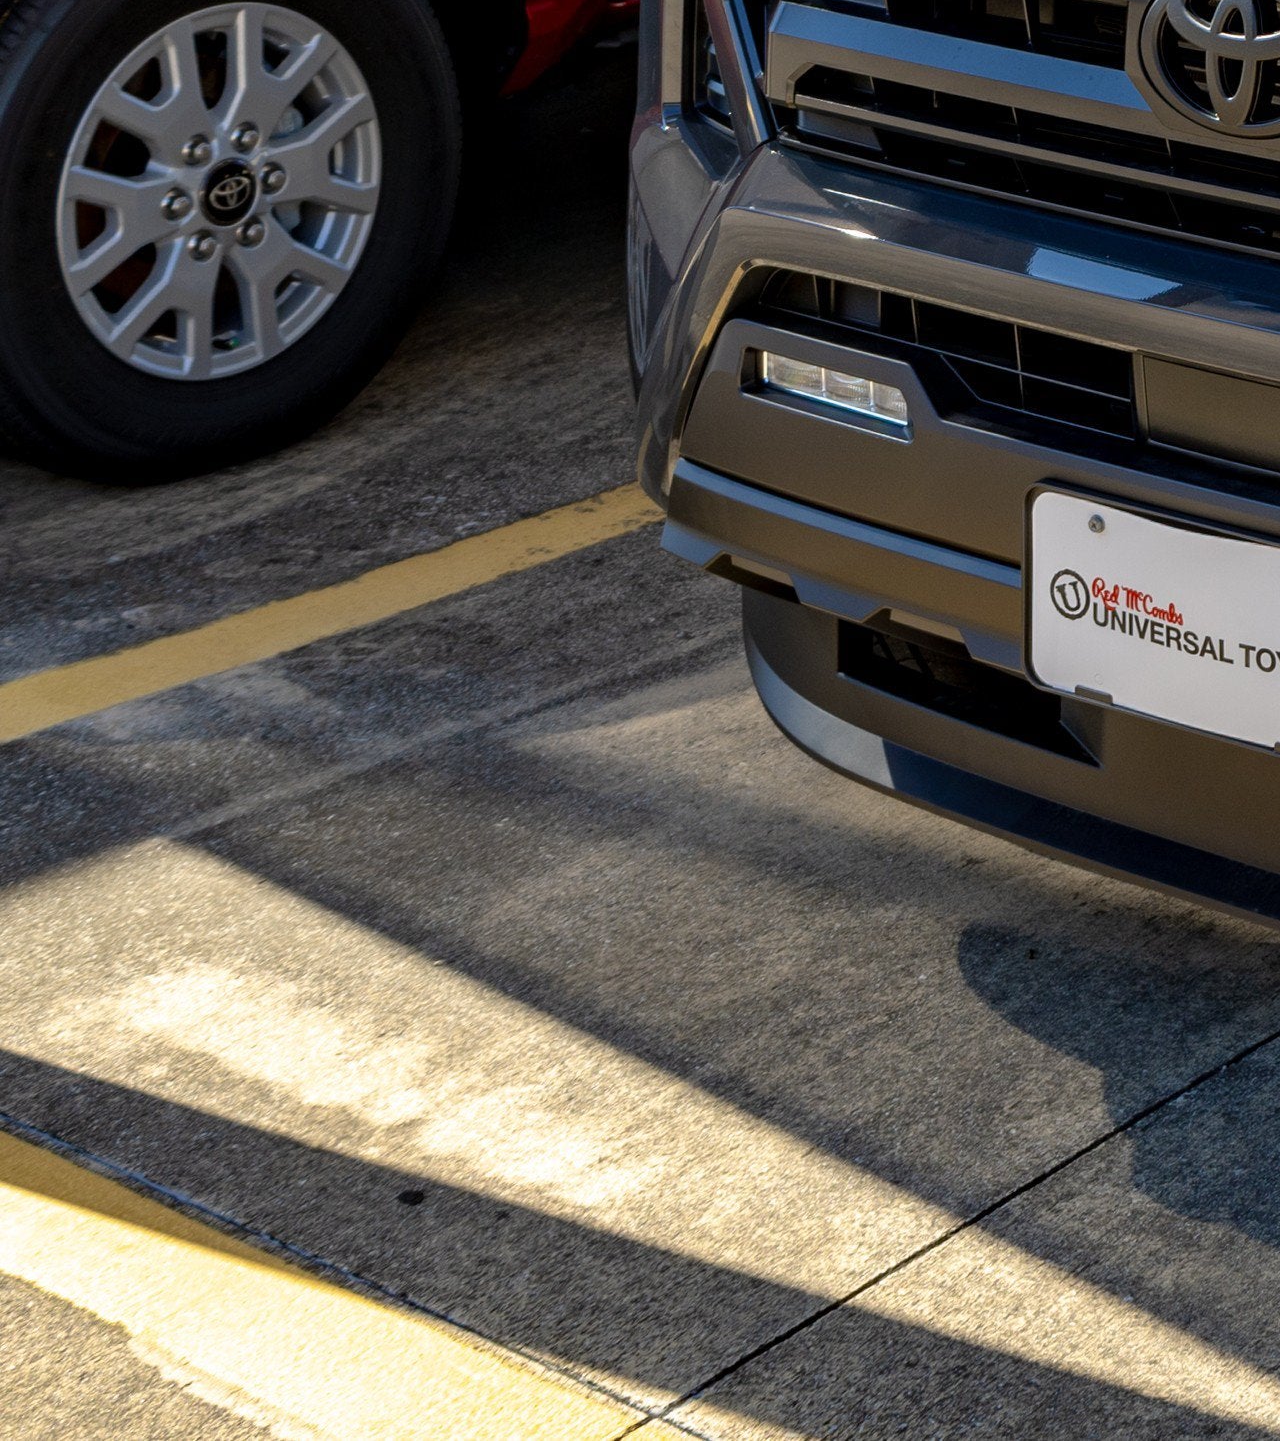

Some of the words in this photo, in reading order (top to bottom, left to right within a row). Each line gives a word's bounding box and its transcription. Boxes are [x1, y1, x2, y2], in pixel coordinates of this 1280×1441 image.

[1092, 577, 1120, 611] Red
[1121, 585, 1184, 626] McCombs
[1093, 603, 1234, 665] UNIVERSAL
